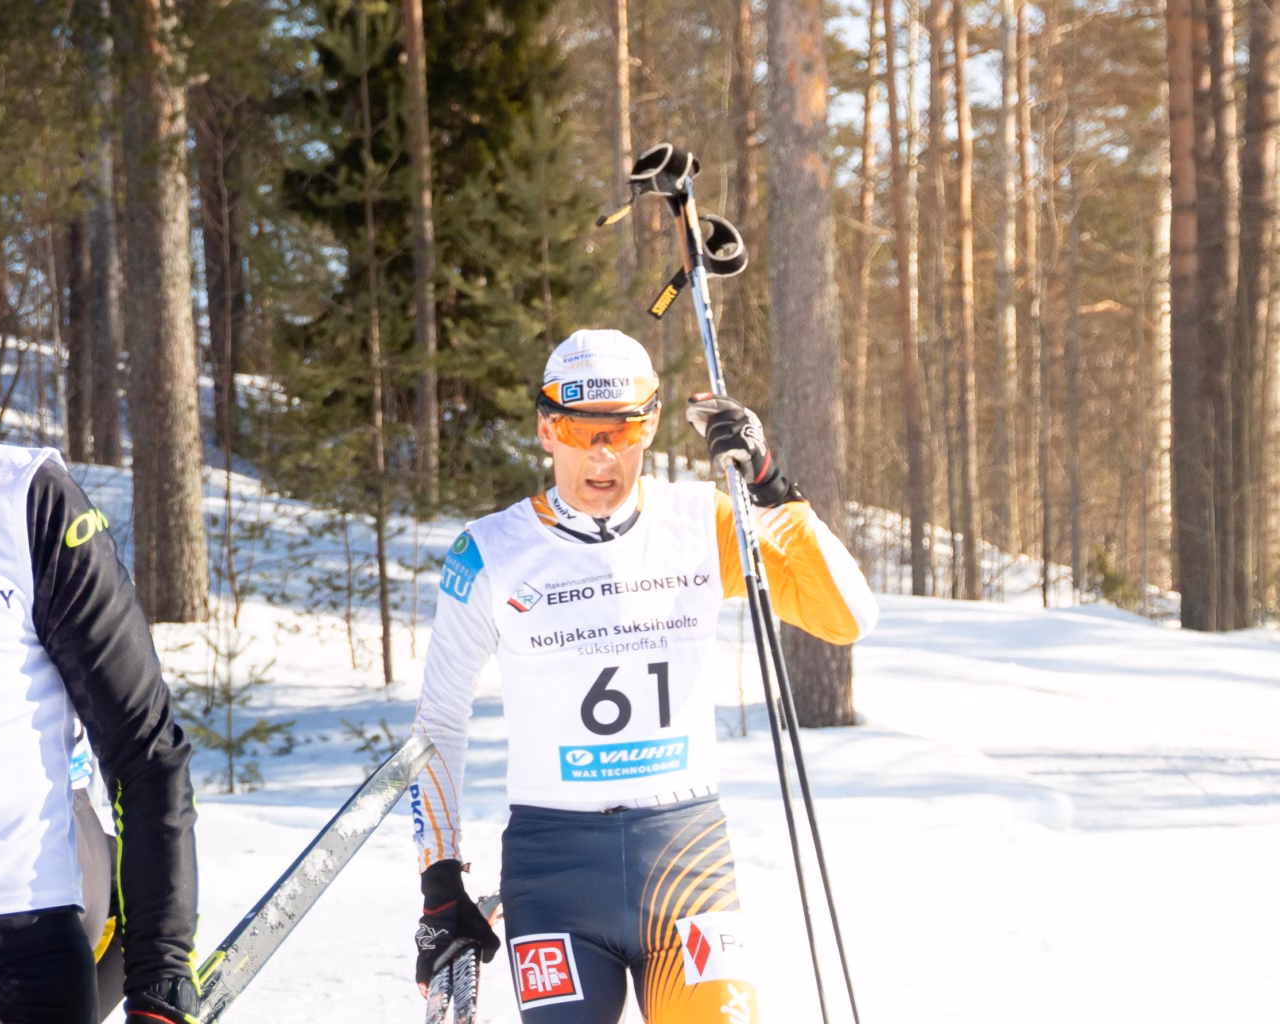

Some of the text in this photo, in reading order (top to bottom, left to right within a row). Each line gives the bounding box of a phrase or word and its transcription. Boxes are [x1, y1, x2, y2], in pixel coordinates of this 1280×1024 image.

[547, 587, 595, 607] EERO
[601, 575, 688, 597] REIJONEN
[530, 615, 699, 649] Noljakan suksihuolto
[577, 638, 668, 657] suksiproffa.fi
[580, 661, 671, 736] 61
[599, 742, 684, 763] VAUHTI
[572, 760, 680, 779] WAX TECHNOLOGIES
